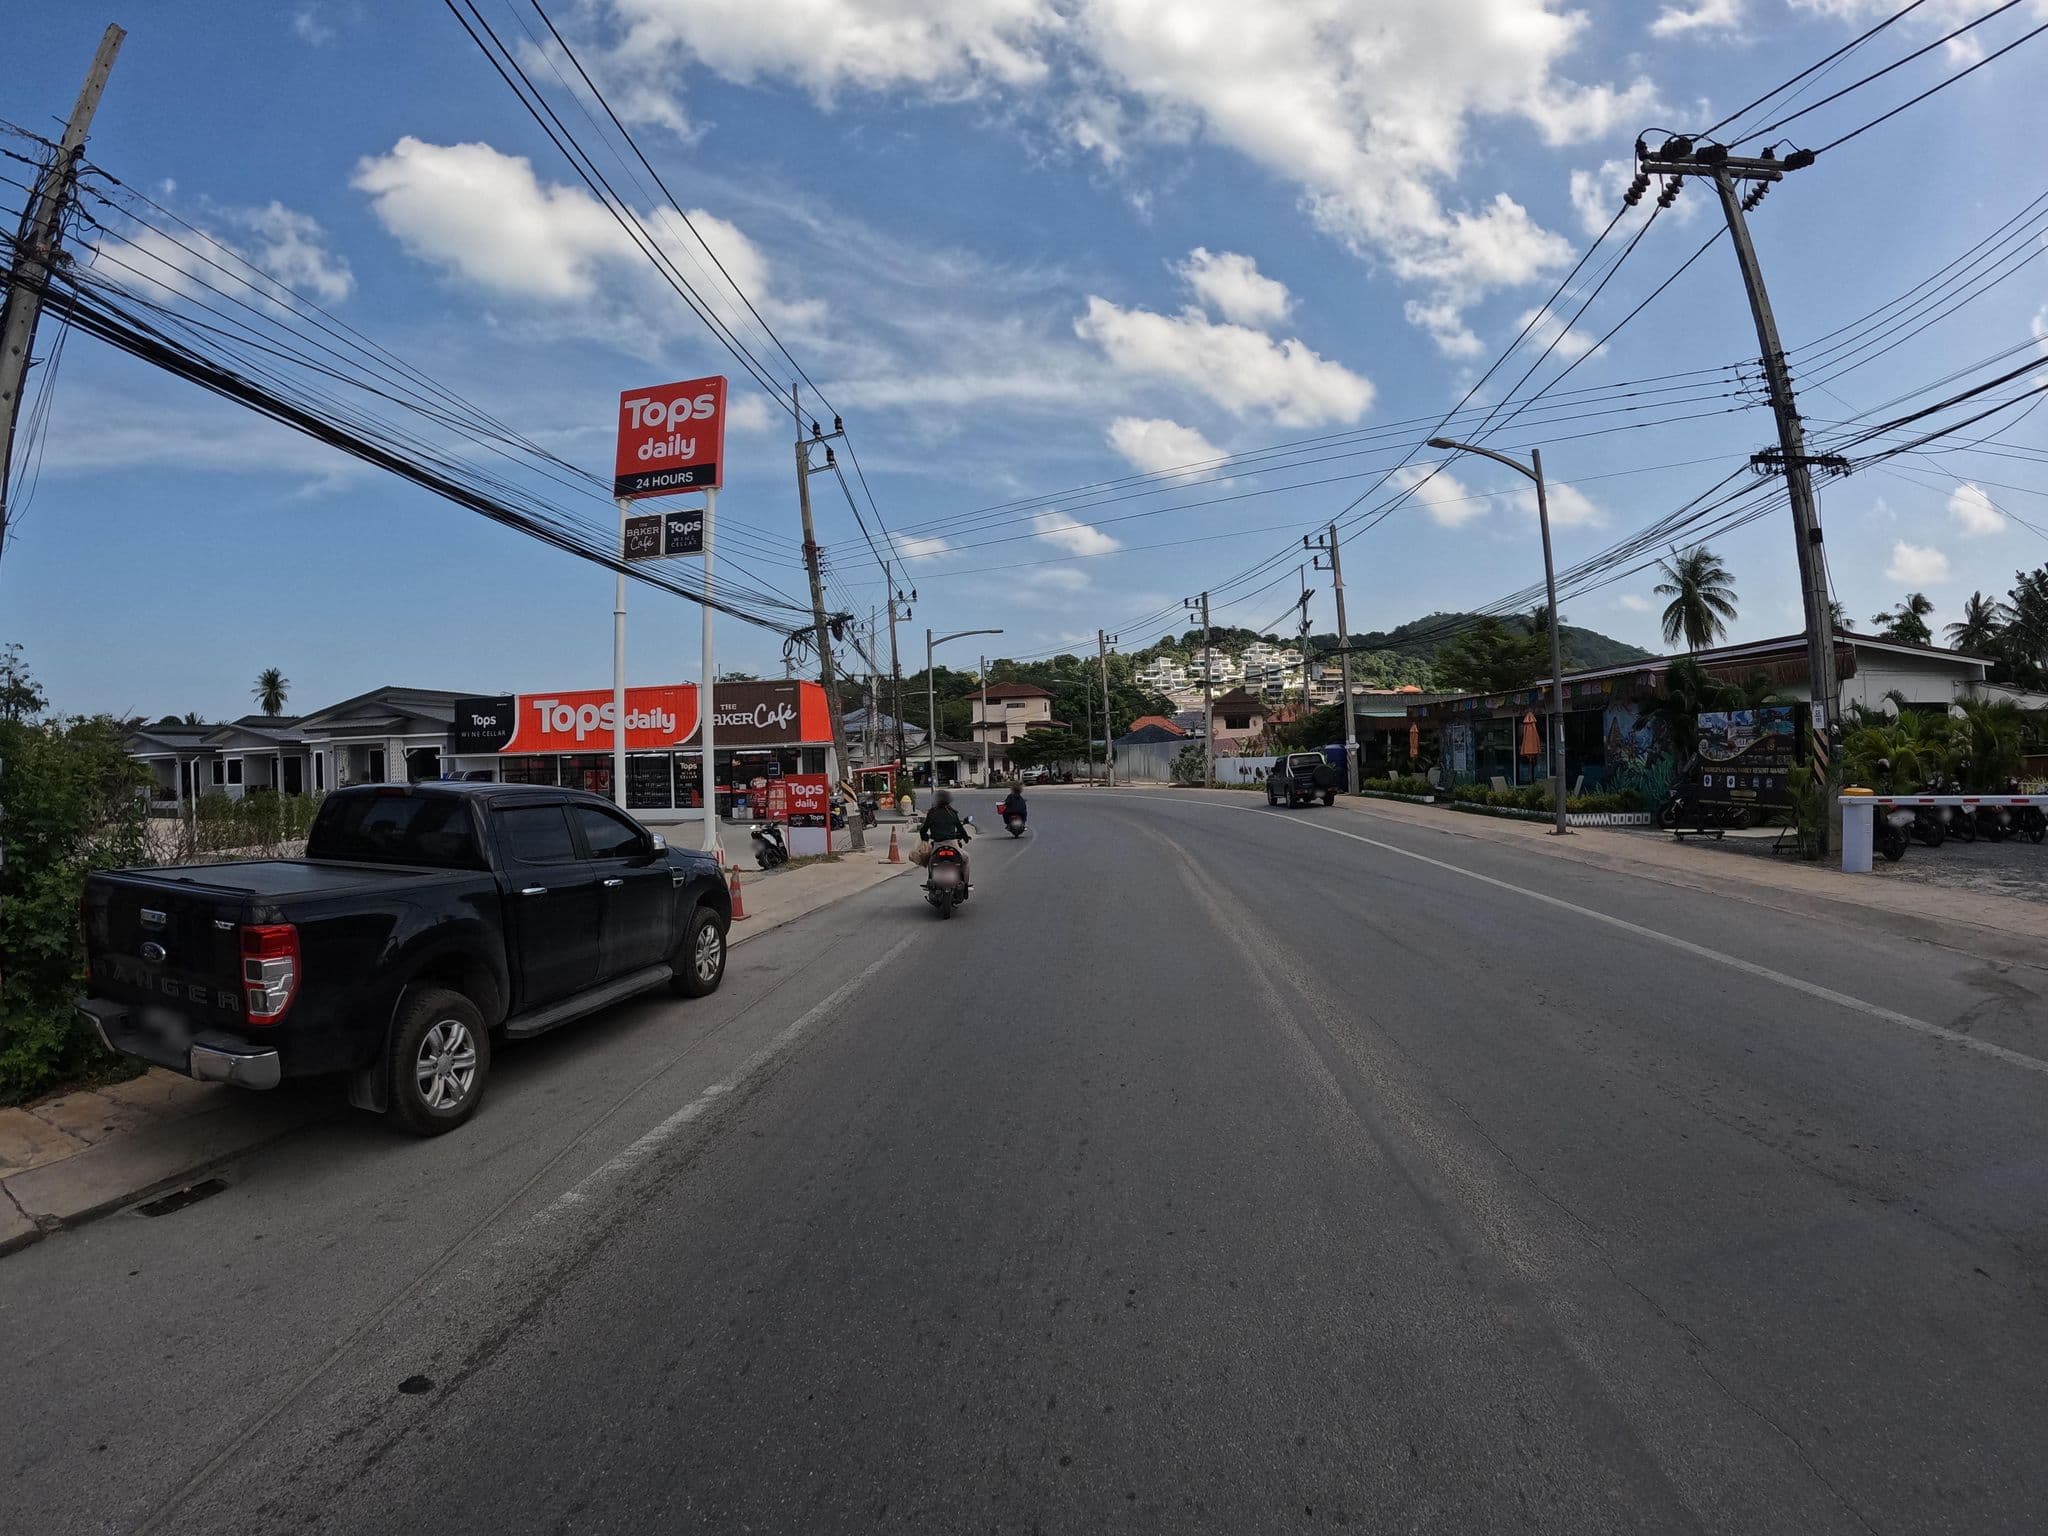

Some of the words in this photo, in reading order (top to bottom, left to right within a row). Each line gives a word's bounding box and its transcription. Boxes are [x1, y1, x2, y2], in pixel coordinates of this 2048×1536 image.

[624, 393, 715, 432] Tops
[637, 433, 696, 460] daily
[636, 478, 650, 489] 24
[652, 472, 694, 487] HOURS
[626, 526, 660, 537] BAKER
[668, 521, 702, 535] Tops
[719, 703, 737, 711] THE
[471, 714, 497, 728] Tops
[533, 699, 615, 742] Tops
[625, 707, 676, 734] daily
[713, 712, 754, 726] AKER
[753, 702, 798, 730] Café
[680, 762, 698, 771] Tops
[788, 783, 824, 797] Tops
[795, 799, 818, 810] daily
